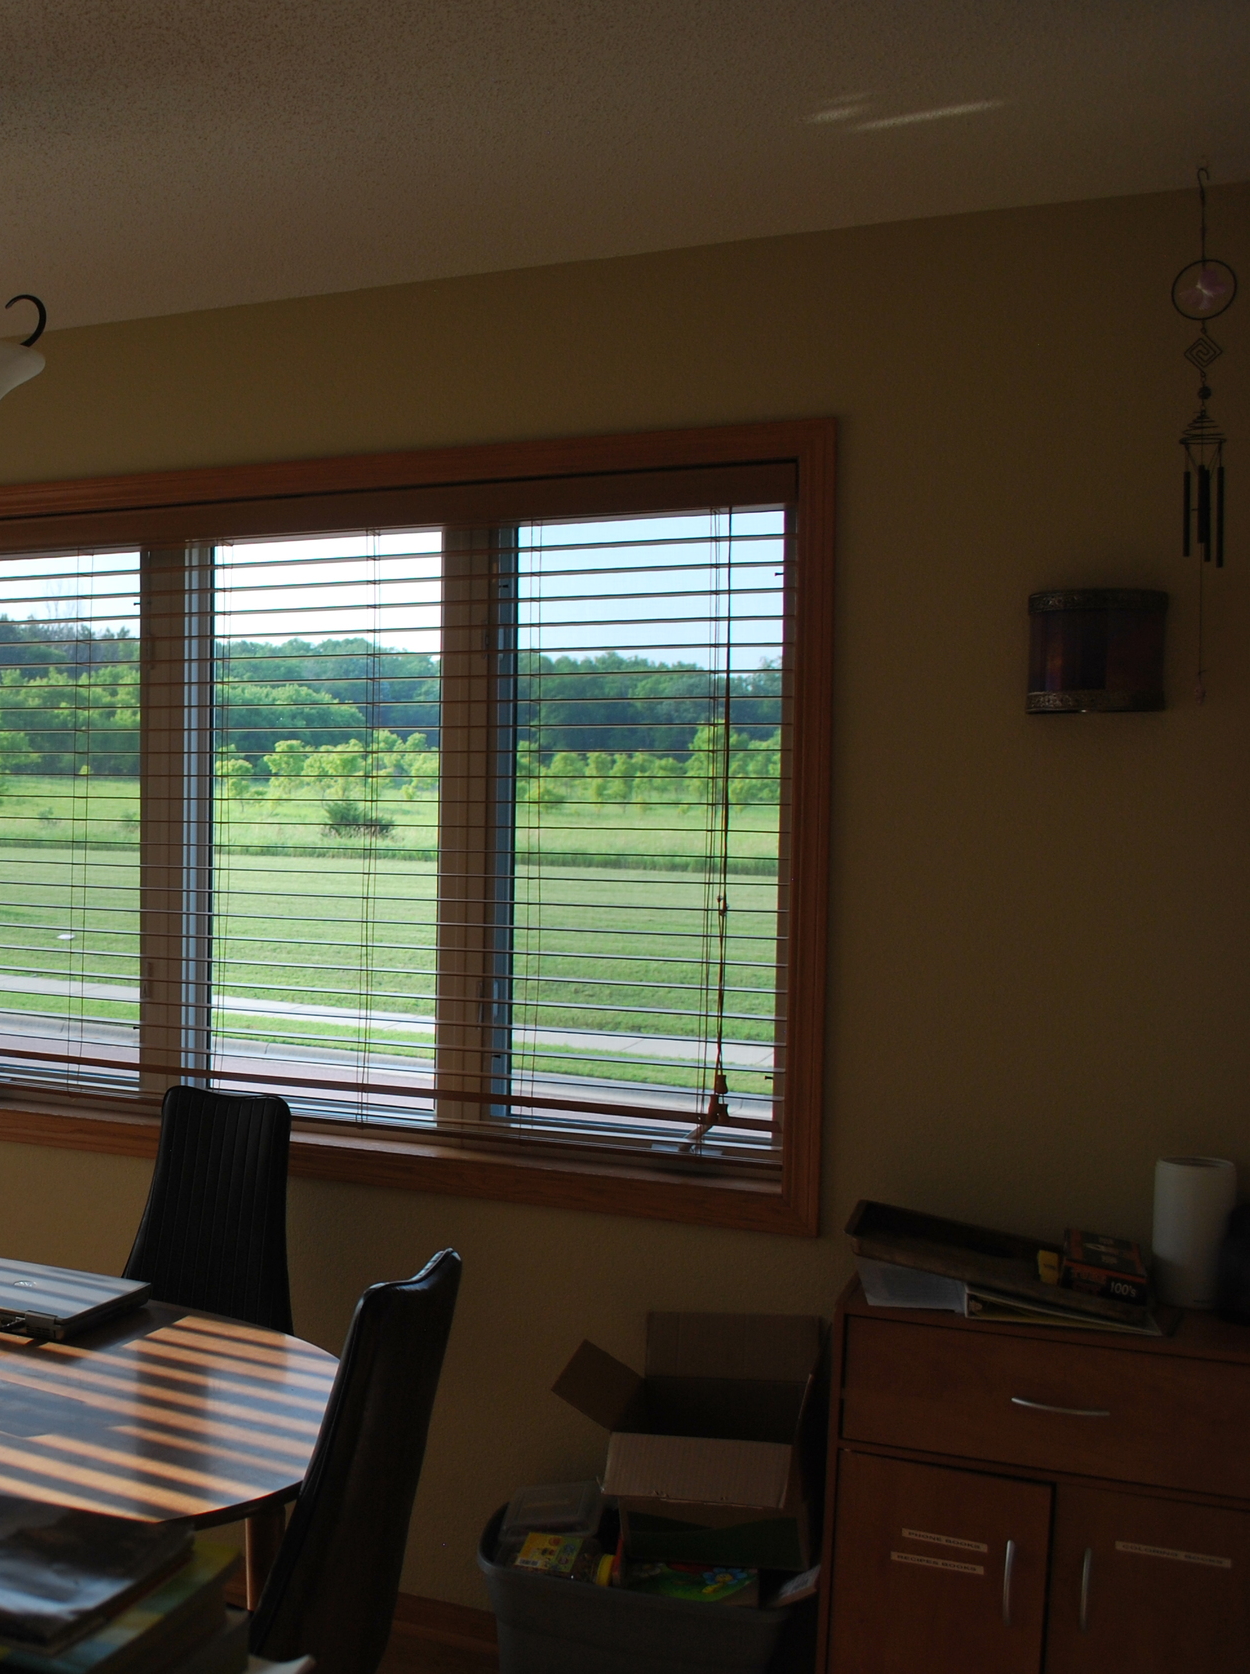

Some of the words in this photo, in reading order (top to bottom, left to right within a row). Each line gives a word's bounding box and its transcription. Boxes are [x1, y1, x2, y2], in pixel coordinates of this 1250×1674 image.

[1110, 1281, 1137, 1298] 100's
[908, 1532, 942, 1542] PHONE
[945, 1539, 981, 1549] BOOKS
[1122, 1544, 1178, 1557] COLORING
[1185, 1554, 1224, 1565] BOOKS
[897, 1555, 939, 1566] RECIPES
[941, 1562, 977, 1572] BOOKS
